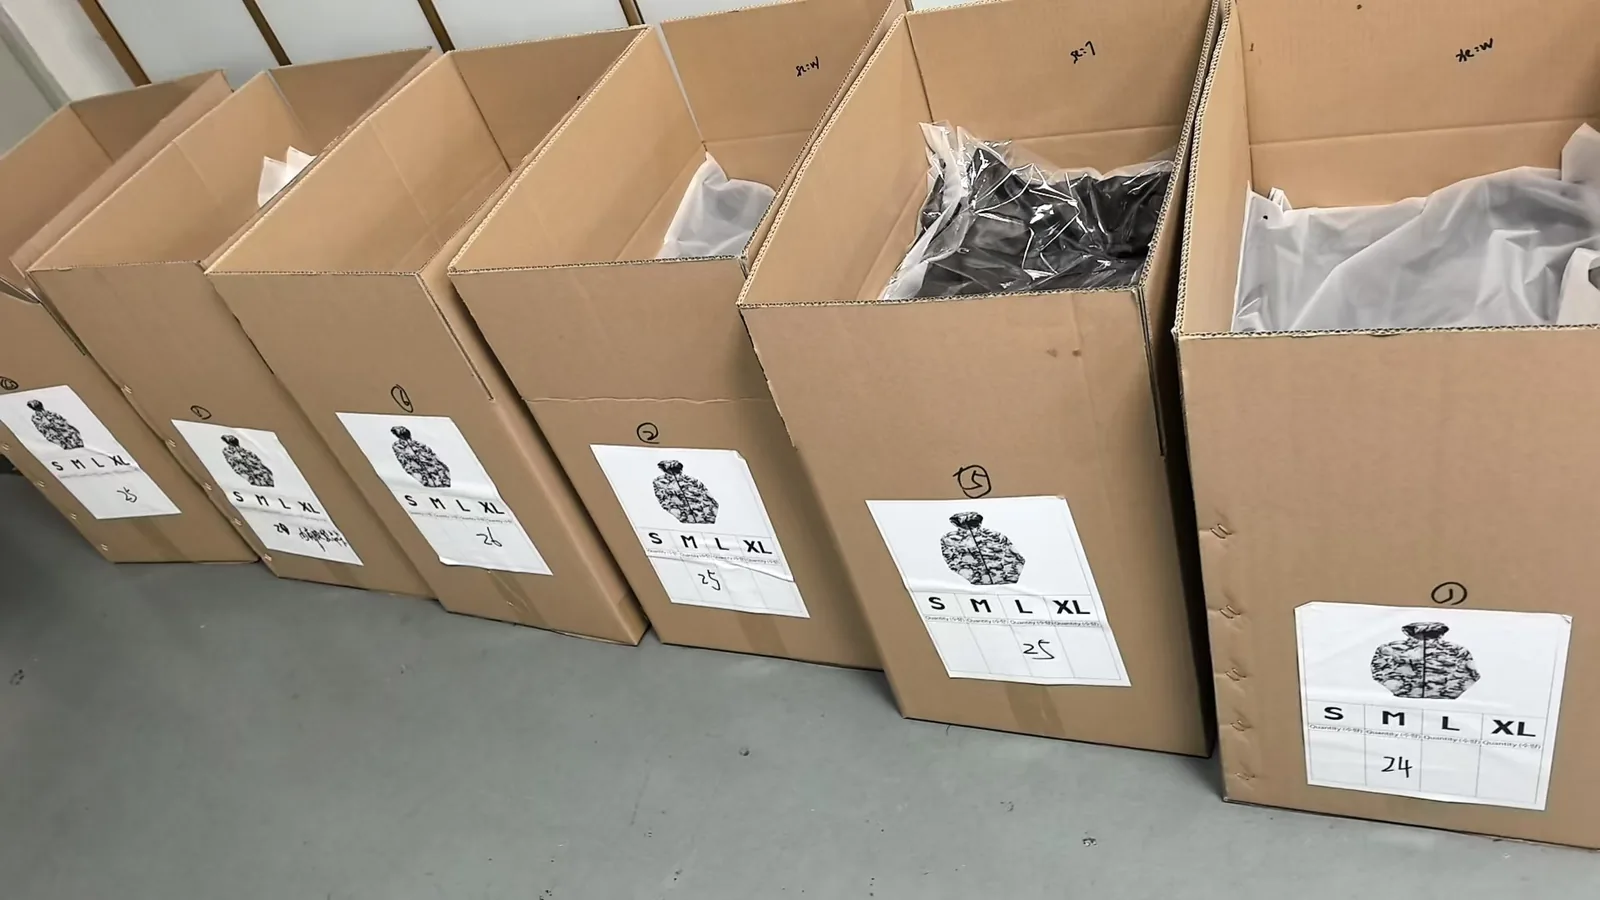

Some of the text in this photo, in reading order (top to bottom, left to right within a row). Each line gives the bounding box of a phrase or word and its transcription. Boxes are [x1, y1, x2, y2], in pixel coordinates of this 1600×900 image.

[51, 455, 131, 472] S M L XL
[233, 491, 245, 502] S
[254, 494, 270, 507] M
[278, 498, 292, 510] L
[297, 501, 321, 515] XL
[404, 495, 506, 515] S M L XL
[476, 526, 503, 548] 26
[648, 532, 773, 555] S M L XL
[698, 569, 721, 591] 25
[928, 596, 1091, 615] S M L XL
[1022, 639, 1055, 660] 25
[1324, 706, 1536, 738] S M L XL
[1381, 756, 1413, 779] 24
